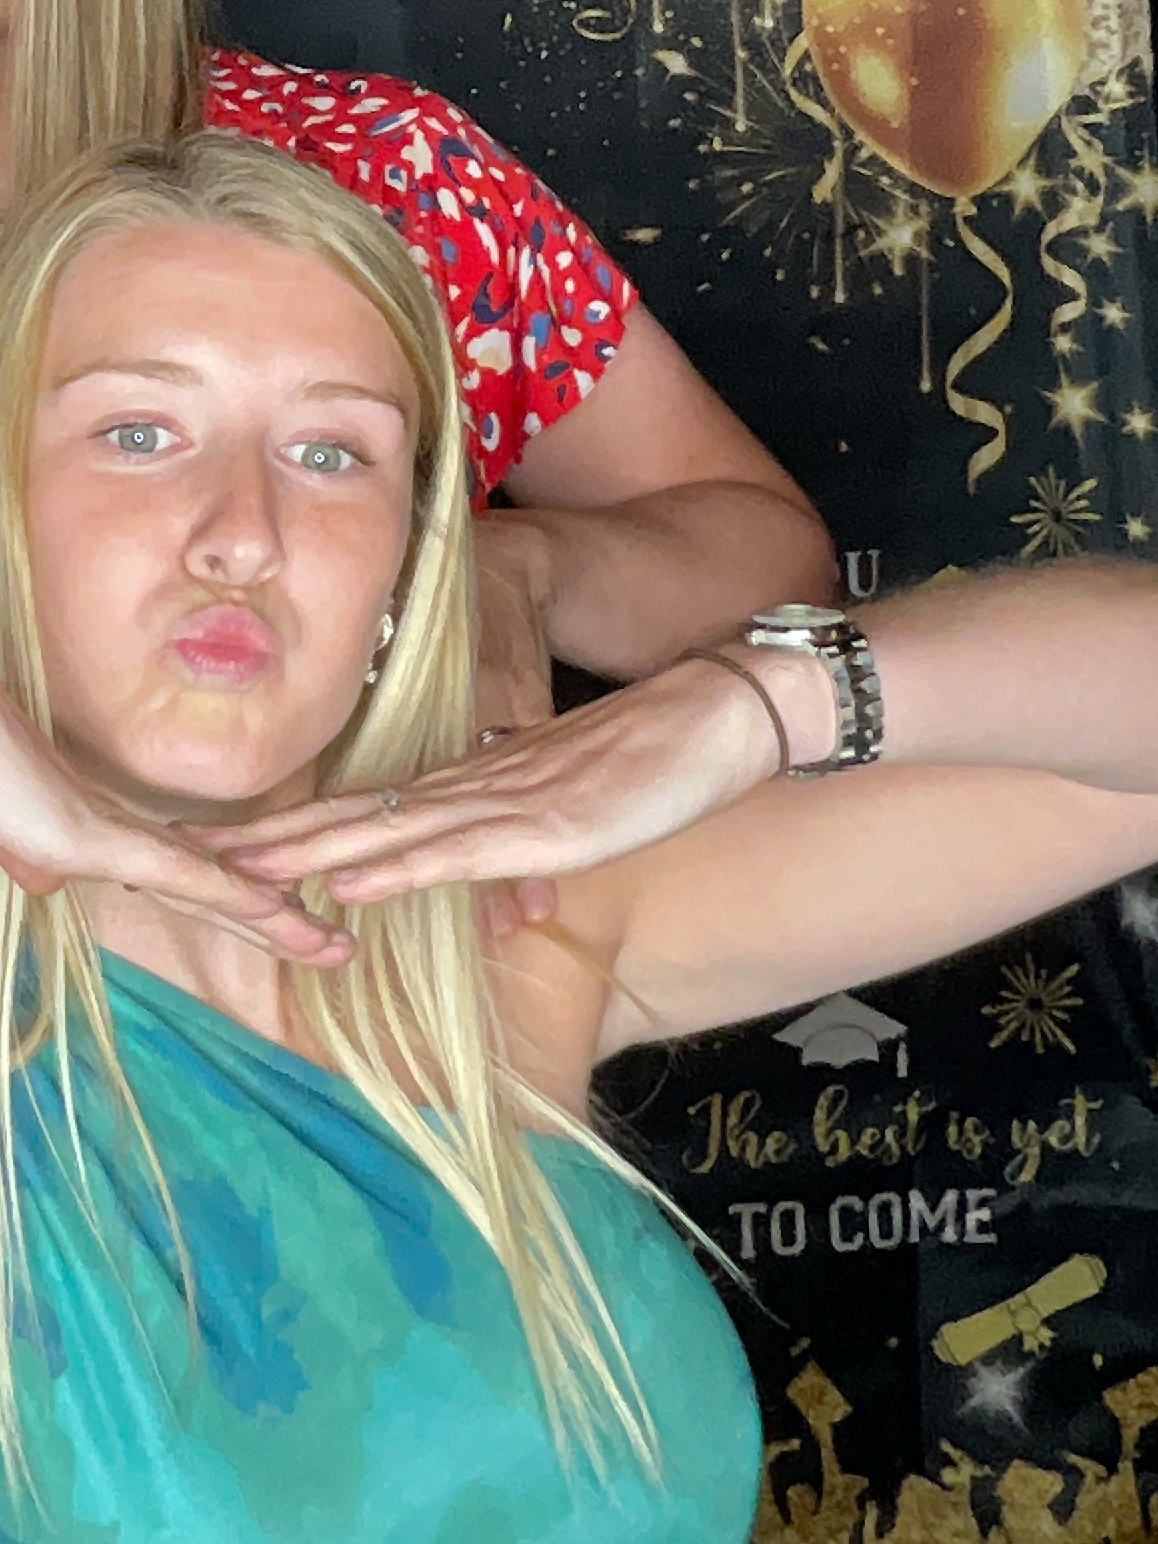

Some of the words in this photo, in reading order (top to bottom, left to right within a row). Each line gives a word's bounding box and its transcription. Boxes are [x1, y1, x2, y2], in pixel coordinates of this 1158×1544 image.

[683, 1089, 797, 1174] The
[813, 1085, 936, 1167] best
[946, 1110, 995, 1159] is
[1004, 1085, 1103, 1186] yet
[728, 1200, 806, 1260] TO
[828, 1188, 997, 1252] COME
